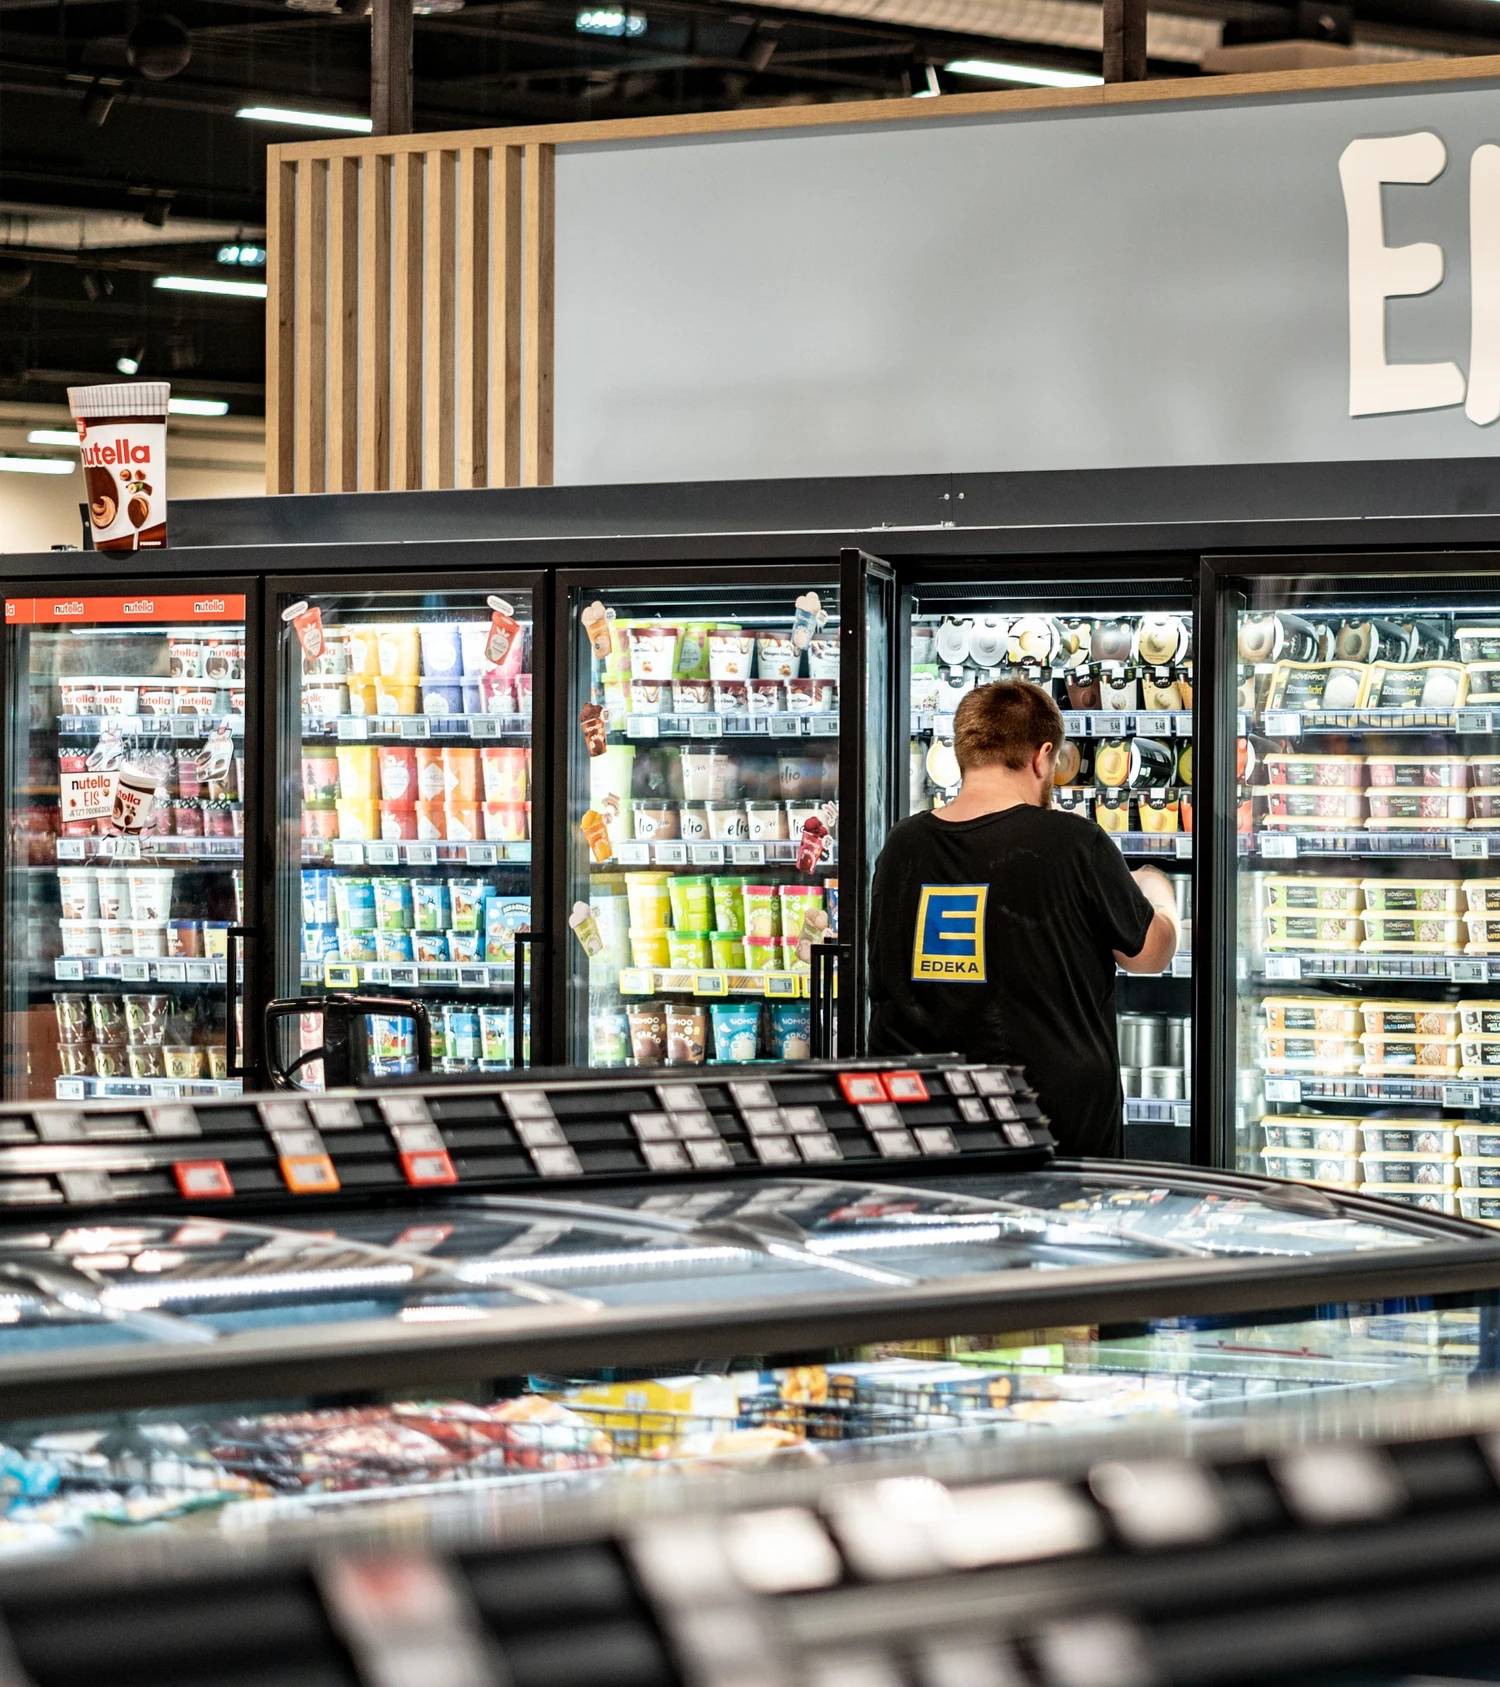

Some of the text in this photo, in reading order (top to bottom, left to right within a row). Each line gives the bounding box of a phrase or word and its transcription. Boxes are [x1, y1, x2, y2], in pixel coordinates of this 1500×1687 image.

[55, 602, 83, 614] nutella
[124, 601, 153, 612] nutella
[195, 600, 224, 611] nutella
[71, 775, 111, 791] nutella
[84, 791, 100, 807] EIS
[69, 807, 85, 817] JETZT
[639, 818, 653, 834] lio
[920, 960, 979, 974] EDEKA
